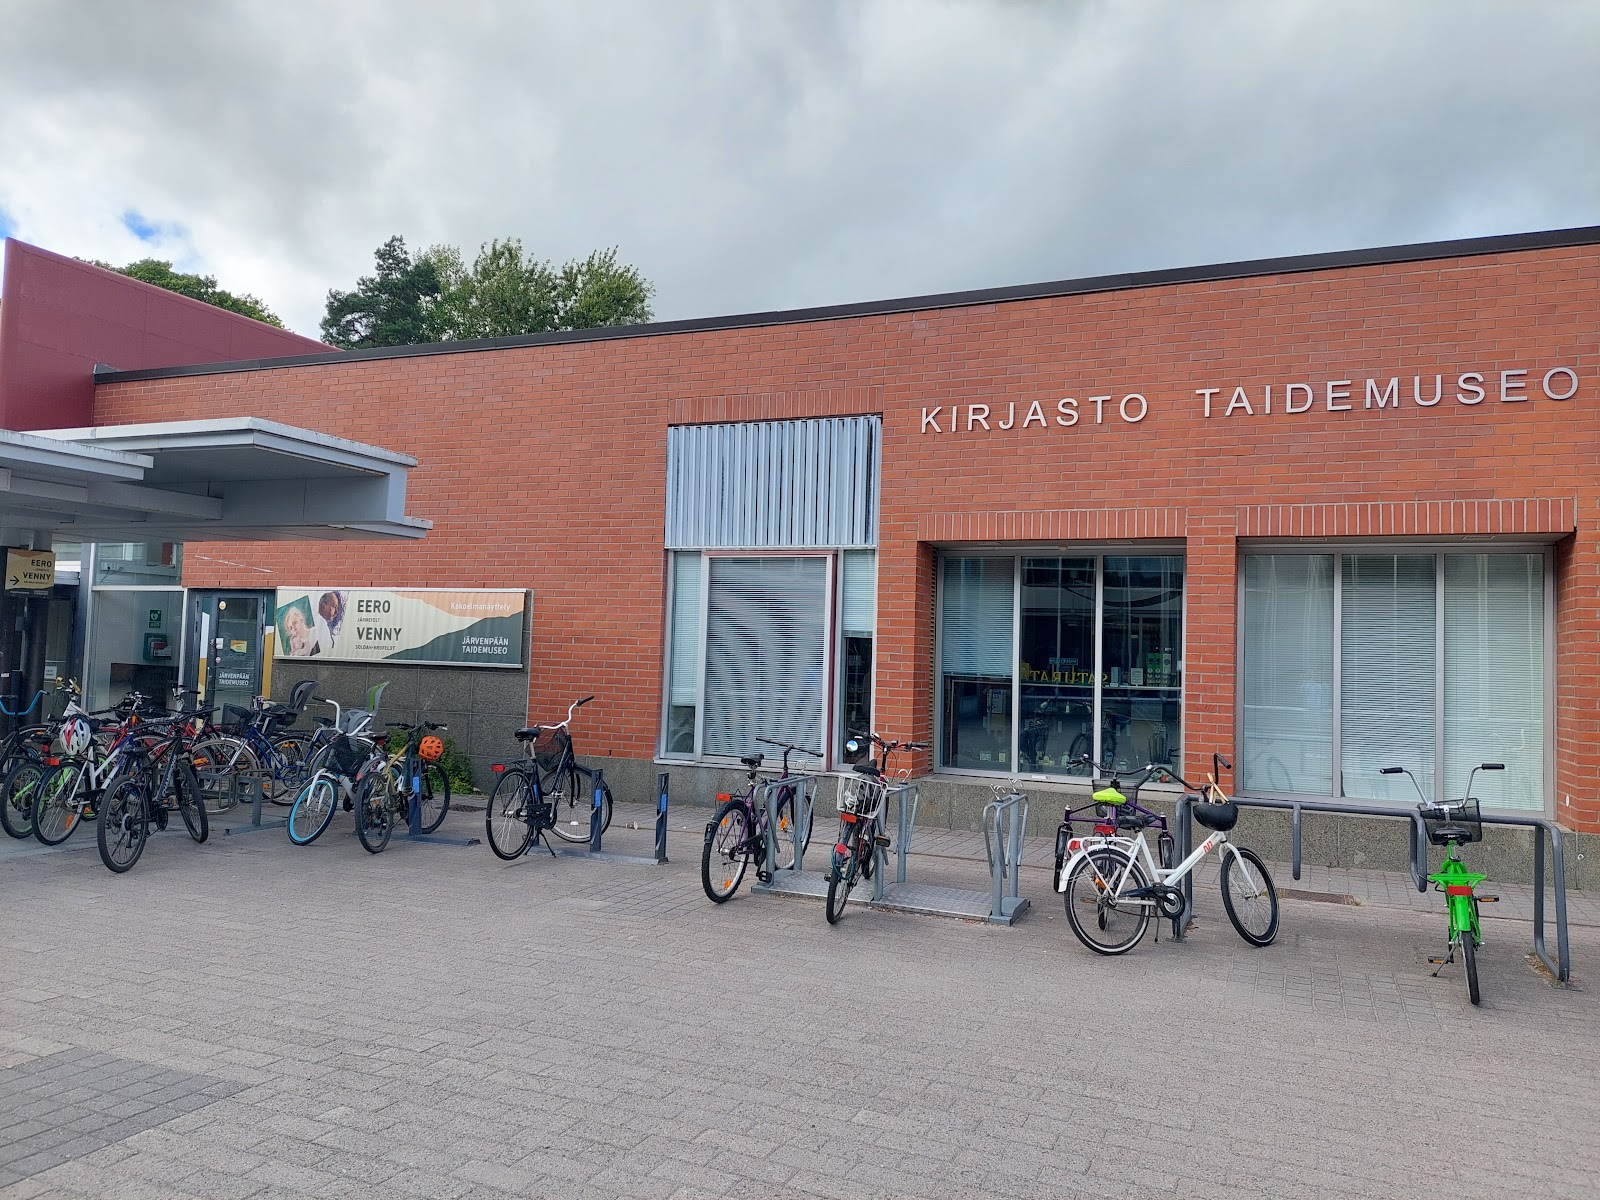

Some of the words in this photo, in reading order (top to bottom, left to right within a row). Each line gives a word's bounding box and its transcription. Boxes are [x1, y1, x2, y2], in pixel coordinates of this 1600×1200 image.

[920, 393, 1149, 434] KIRJASTO
[1195, 366, 1580, 418] TAIDEMUSEO
[31, 559, 52, 568] EERO
[22, 572, 51, 580] VENNY
[357, 599, 391, 613] EERO
[450, 601, 511, 612] Kokoelmanäyttely
[356, 626, 402, 641] VENNY
[461, 635, 509, 646] JÄRVENPÄÄN
[461, 645, 508, 655] TAIDEMUSEO
[218, 671, 250, 680] JÄRVENPÄÄN
[218, 679, 249, 687] TAIDEMUSEO
